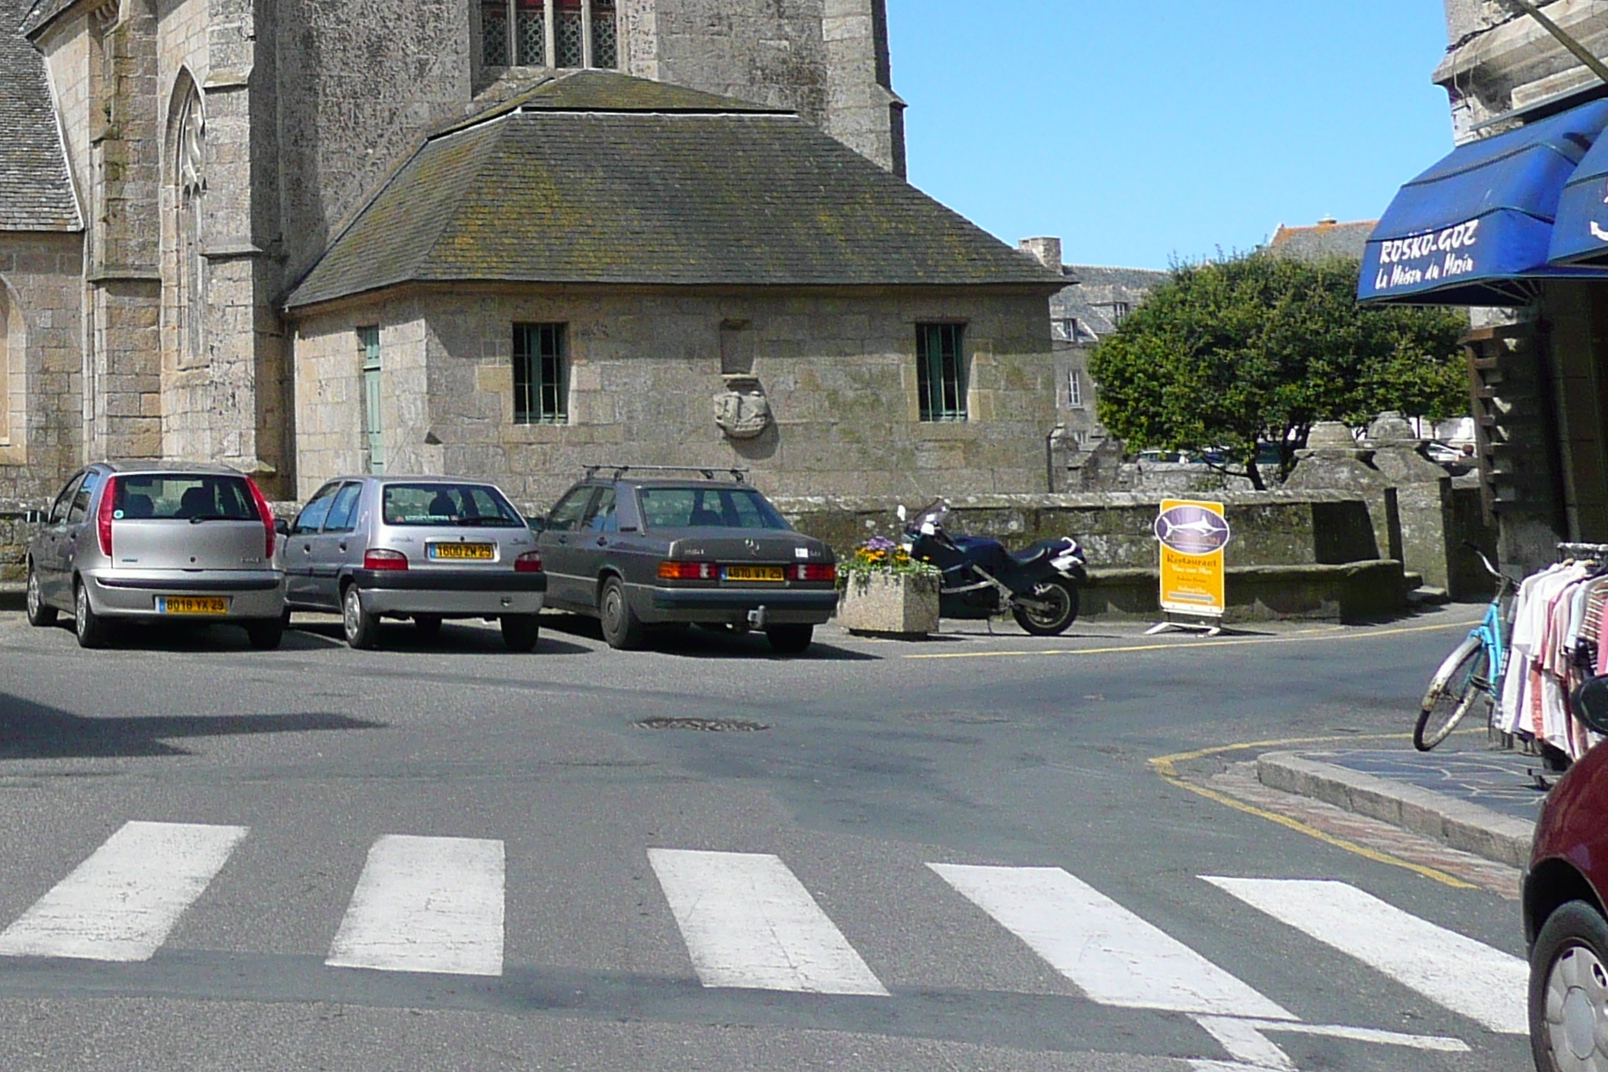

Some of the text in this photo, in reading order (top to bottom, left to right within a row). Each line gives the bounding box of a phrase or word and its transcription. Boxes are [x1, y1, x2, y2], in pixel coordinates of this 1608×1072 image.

[437, 545, 491, 557] 1600 ZW 29
[1167, 553, 1217, 566] Restaurant
[769, 566, 782, 578] 29
[166, 597, 224, 611] 8018 YX 29
